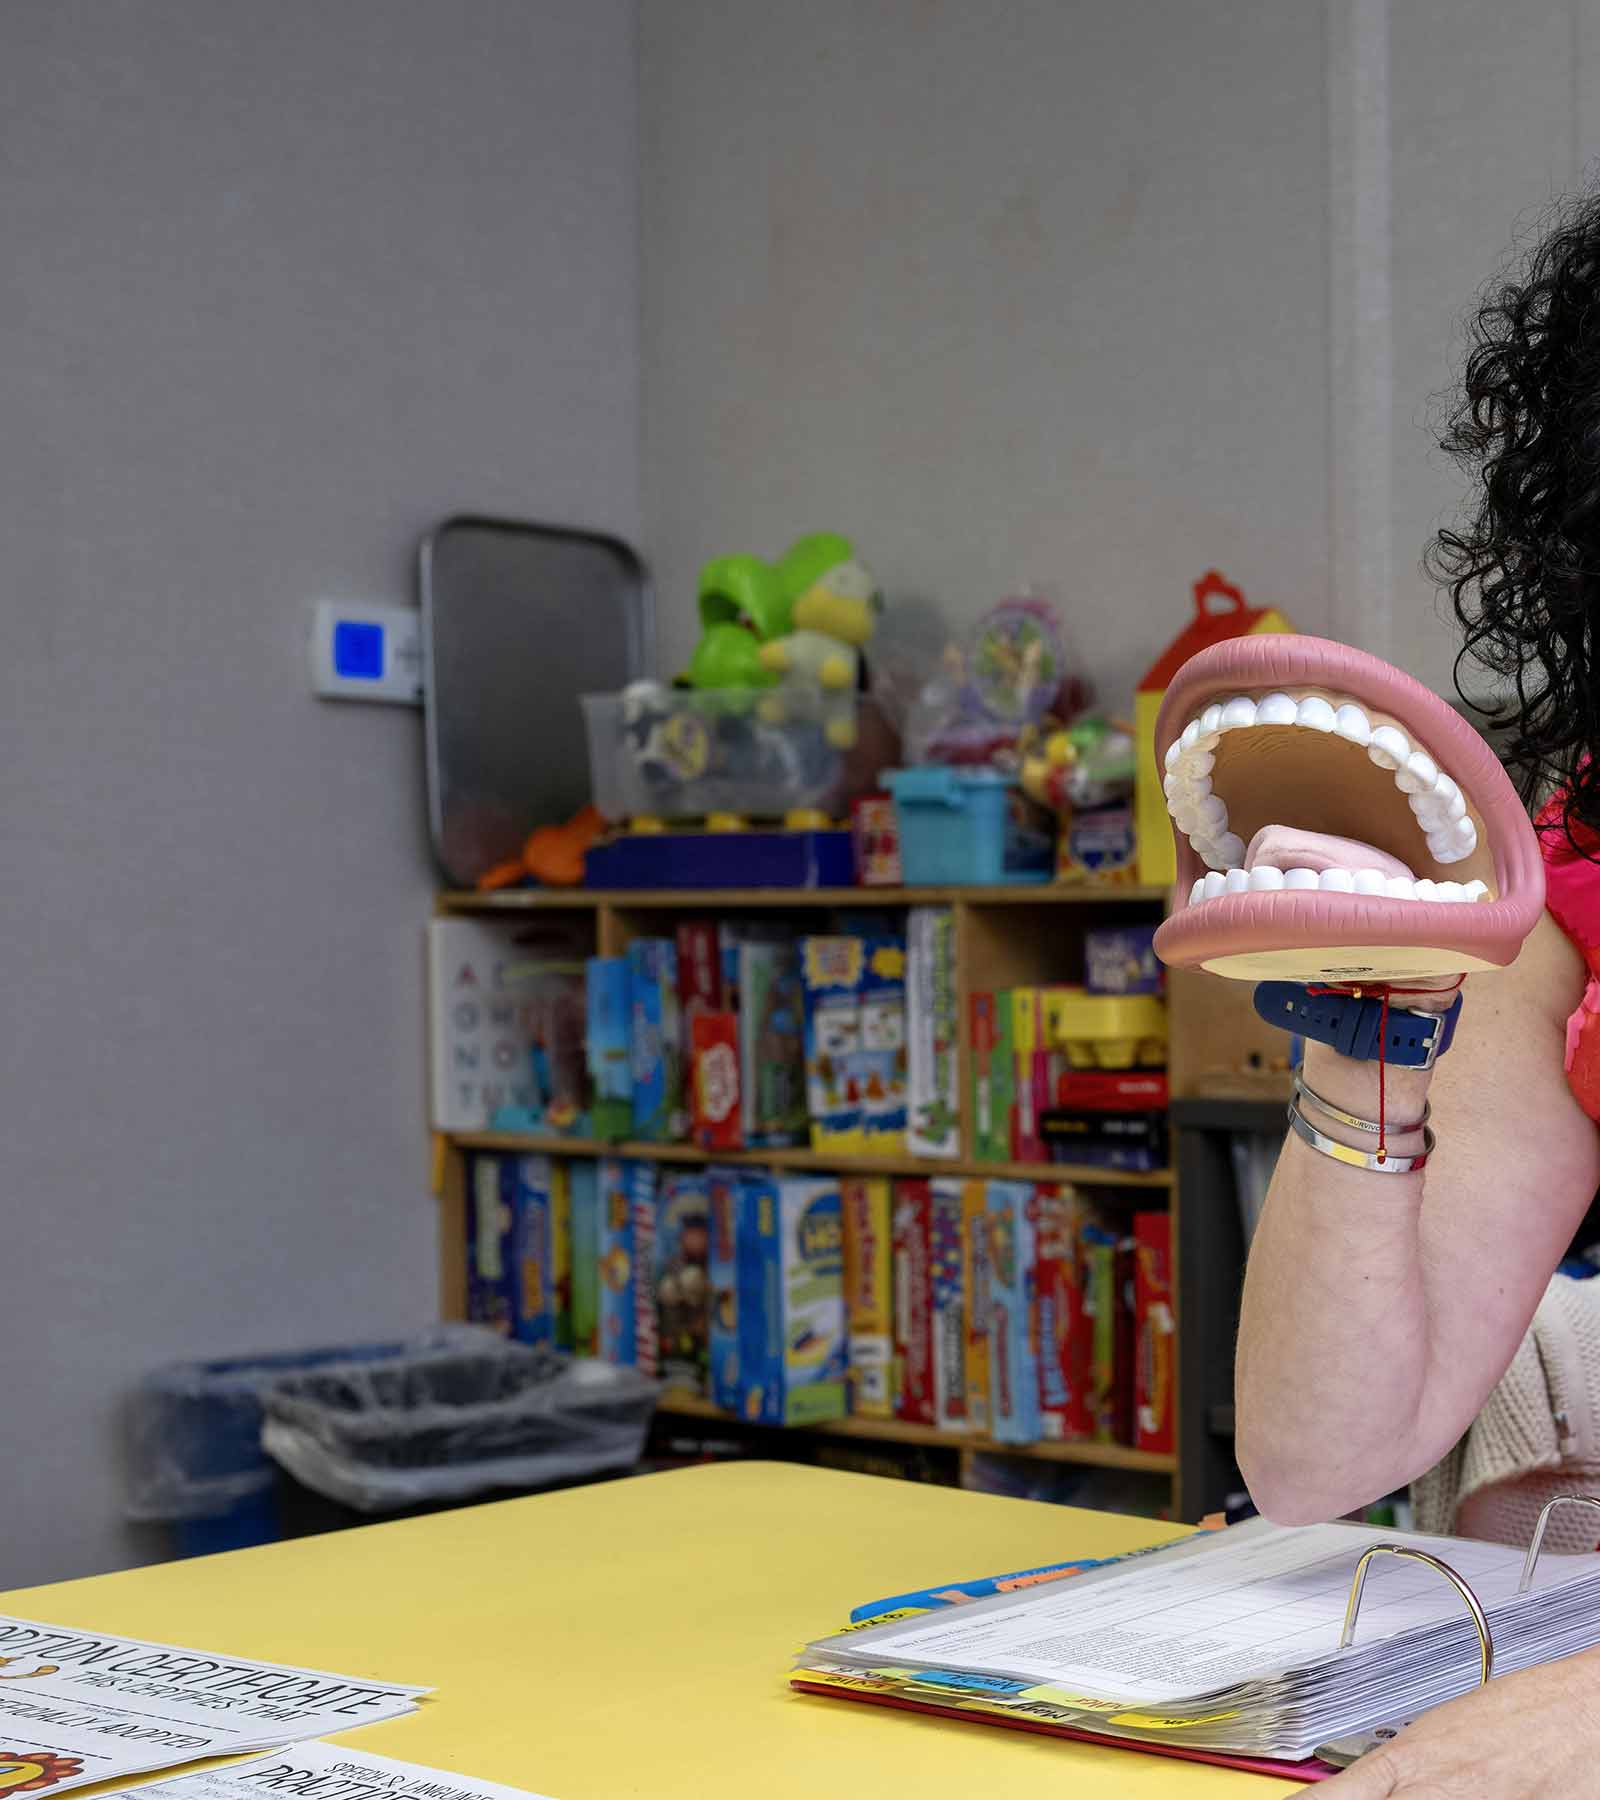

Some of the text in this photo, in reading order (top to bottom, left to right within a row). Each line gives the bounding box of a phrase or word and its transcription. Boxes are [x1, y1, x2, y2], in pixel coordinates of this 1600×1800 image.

[1349, 1118, 1386, 1132] SURVIVO
[61, 1671, 320, 1722] THIS CERTIFIES THAT
[107, 1653, 406, 1714] CERTIFICATE
[86, 1719, 212, 1749] ADOPTED
[324, 1762, 391, 1783] SPEECH
[380, 1775, 405, 1788] &
